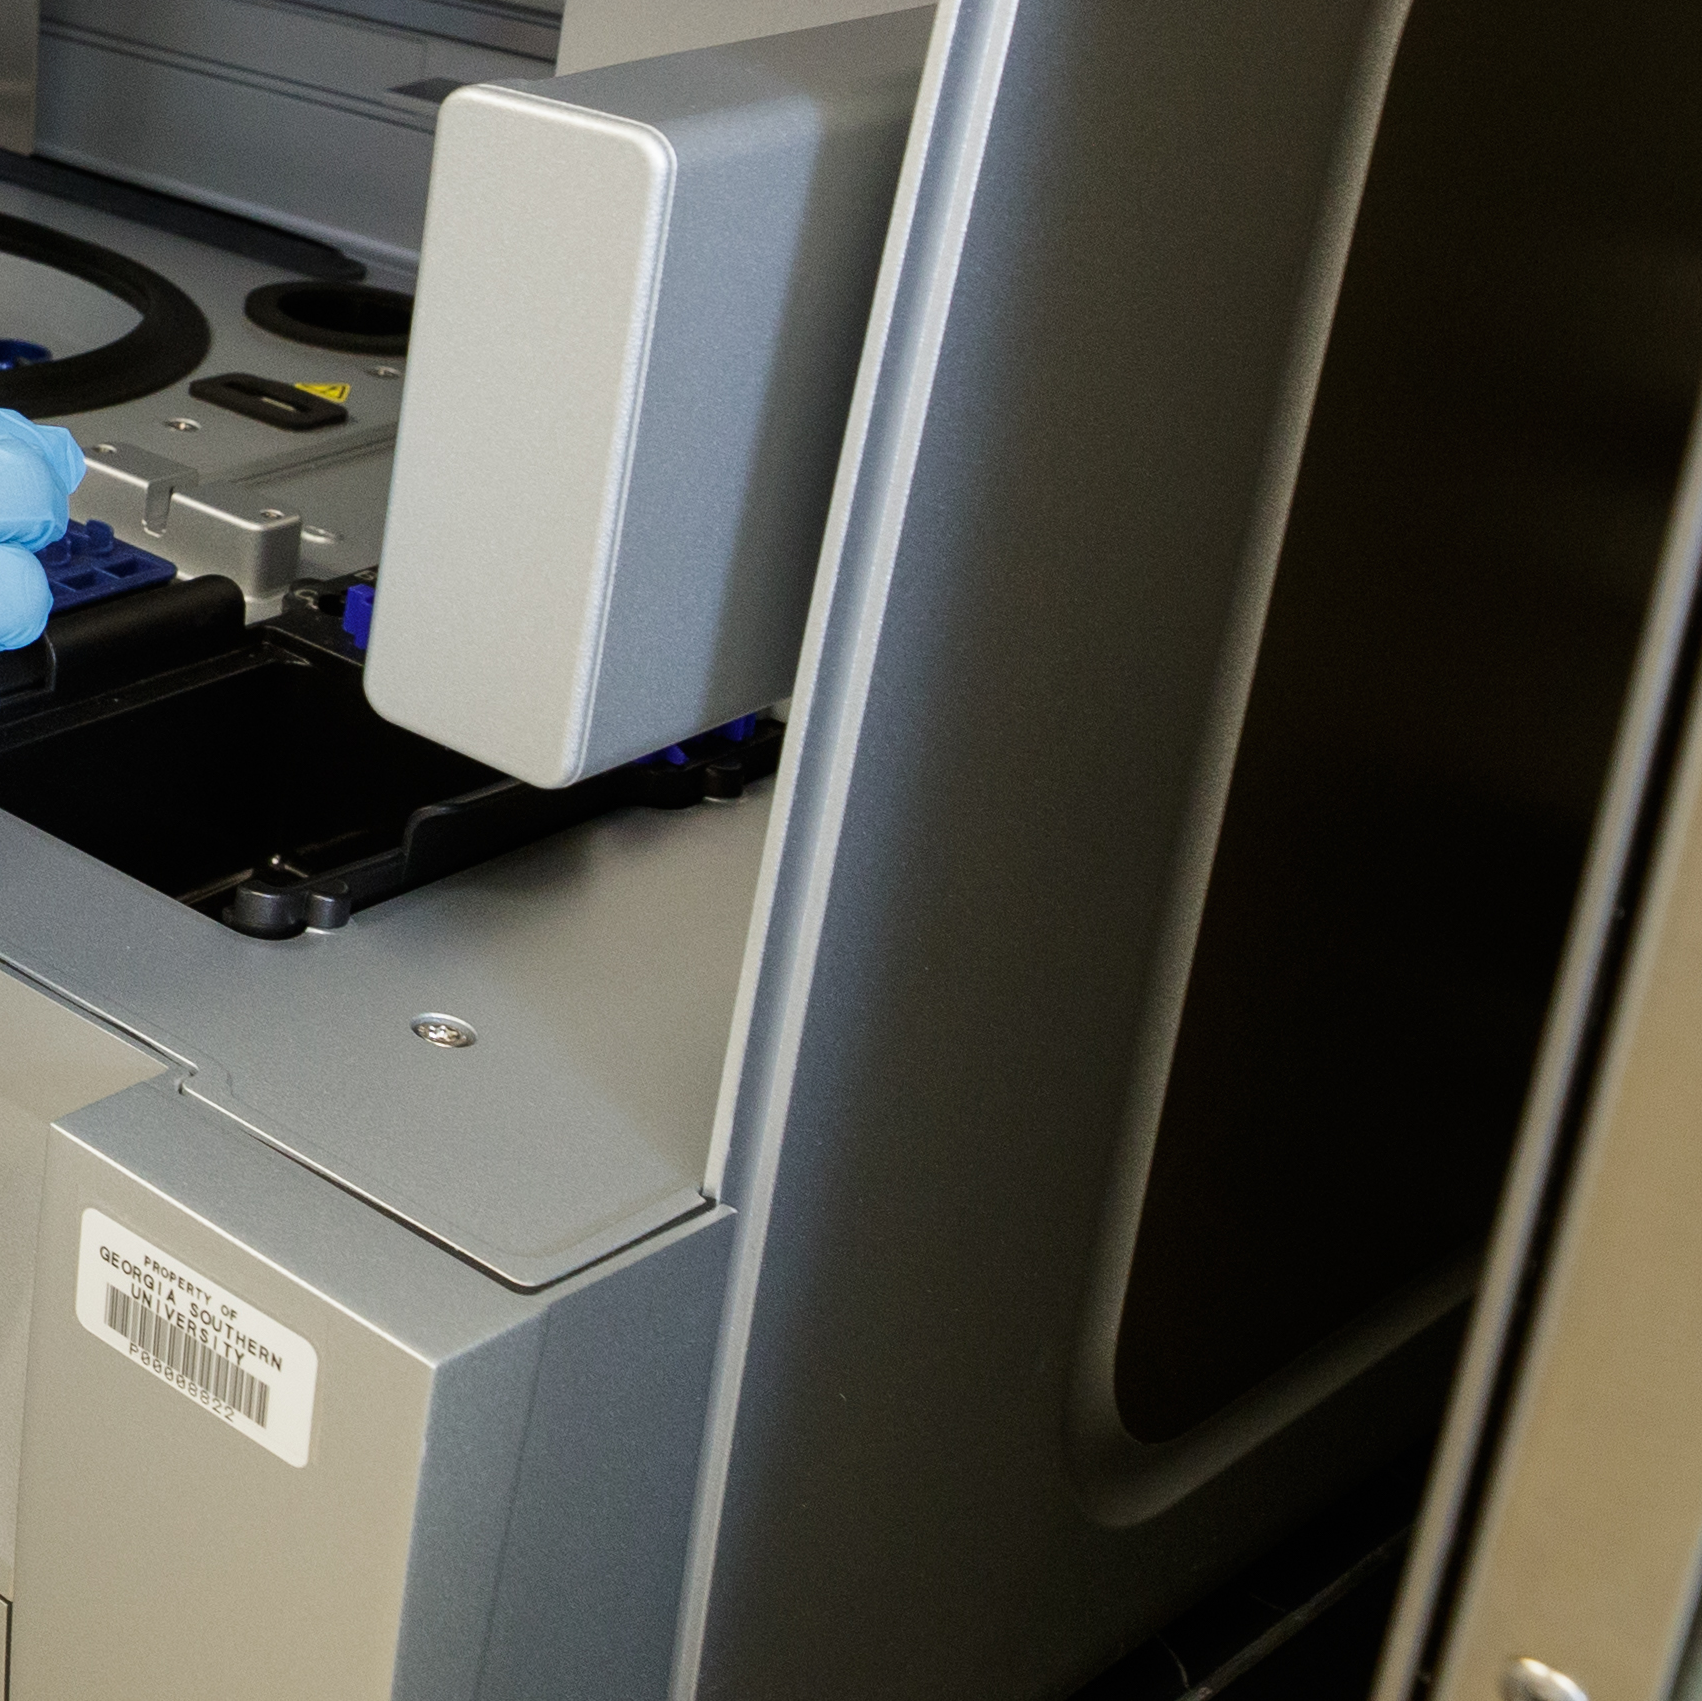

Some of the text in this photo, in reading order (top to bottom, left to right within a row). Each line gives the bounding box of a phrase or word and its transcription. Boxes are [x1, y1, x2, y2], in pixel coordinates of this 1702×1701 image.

[99, 1245, 283, 1373] GEORGIA SOUTHERN
[131, 1283, 245, 1366] UNIVERSITY
[144, 1255, 238, 1321] PROPERTY OF
[129, 1342, 235, 1423] P00008822
